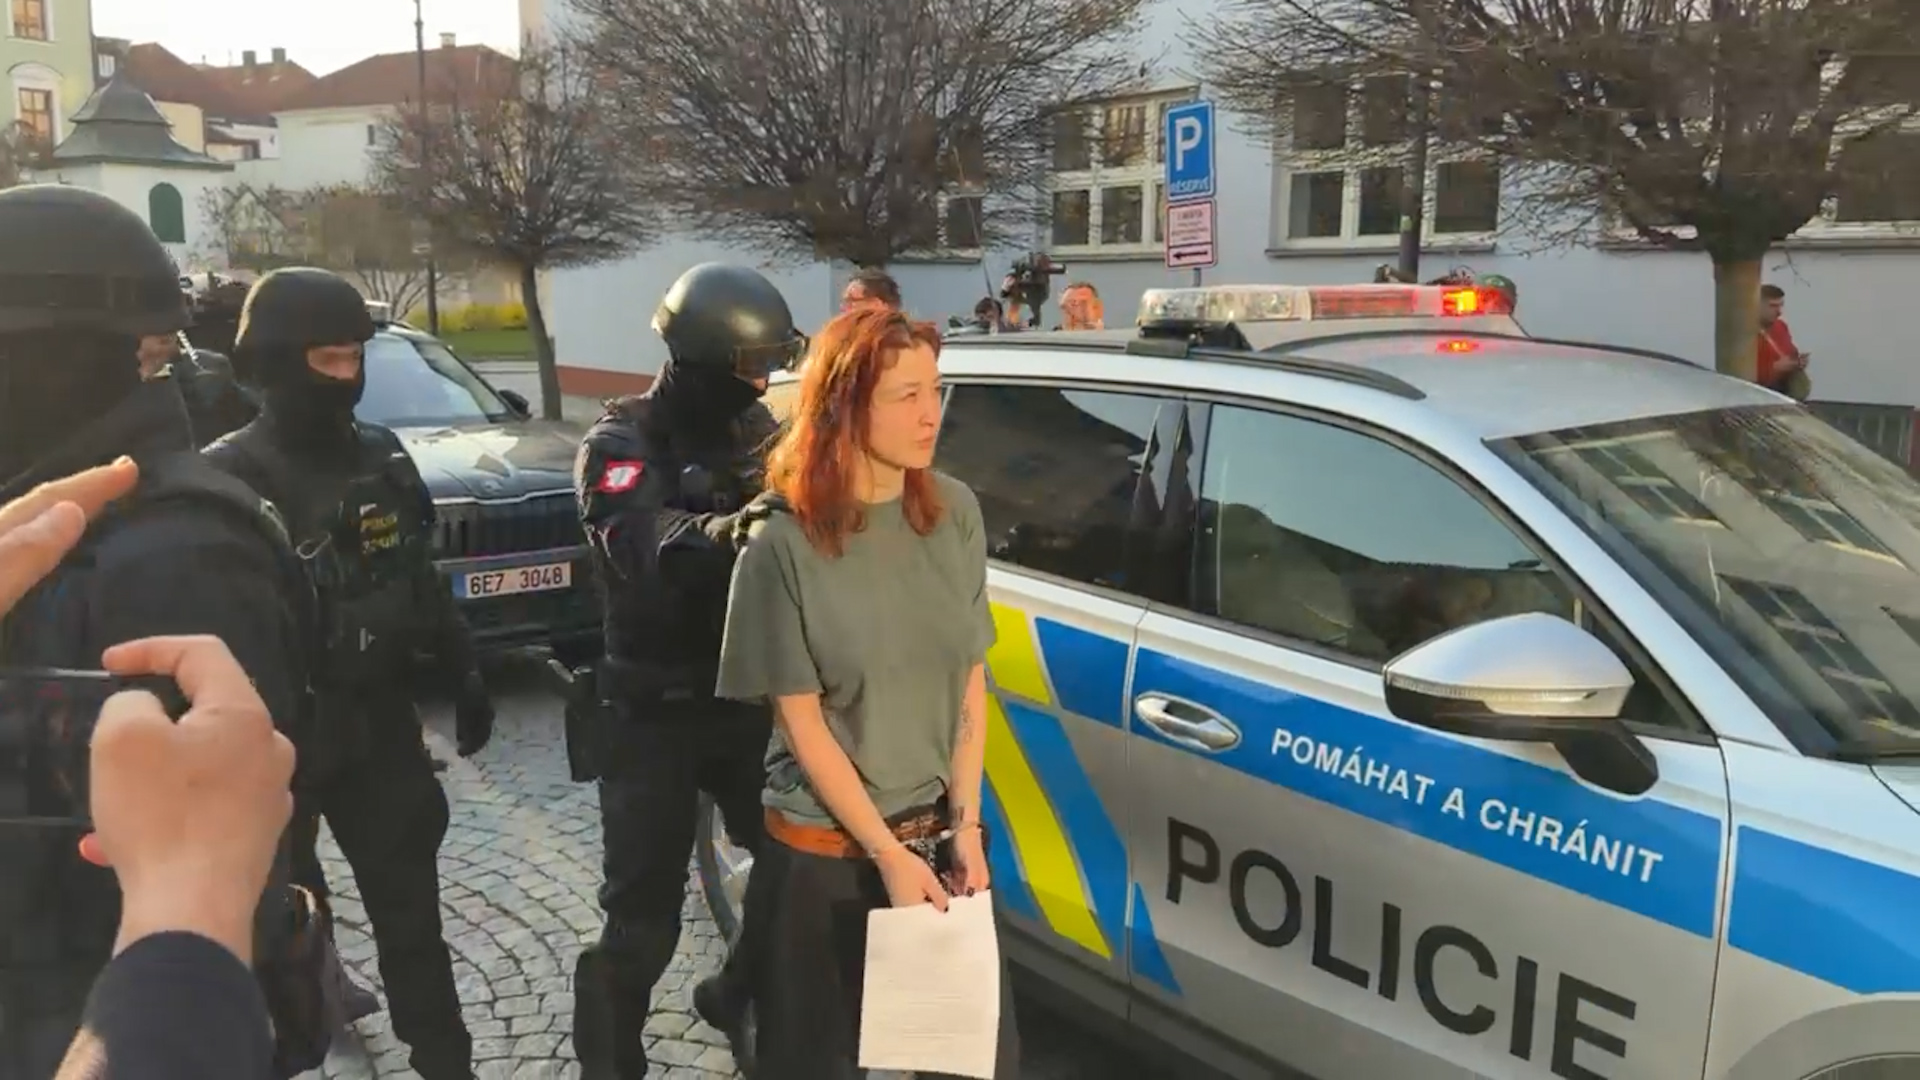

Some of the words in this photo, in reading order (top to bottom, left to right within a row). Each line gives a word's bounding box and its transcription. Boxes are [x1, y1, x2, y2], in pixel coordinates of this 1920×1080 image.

[1175, 116, 1203, 171] P
[470, 572, 506, 595] 6E7
[519, 566, 563, 589] 3048
[1271, 727, 1434, 806] POMÁHAT
[1441, 787, 1465, 819] A
[1479, 798, 1664, 883] CHRÁNIT
[1165, 816, 1637, 1080] POLICIE
